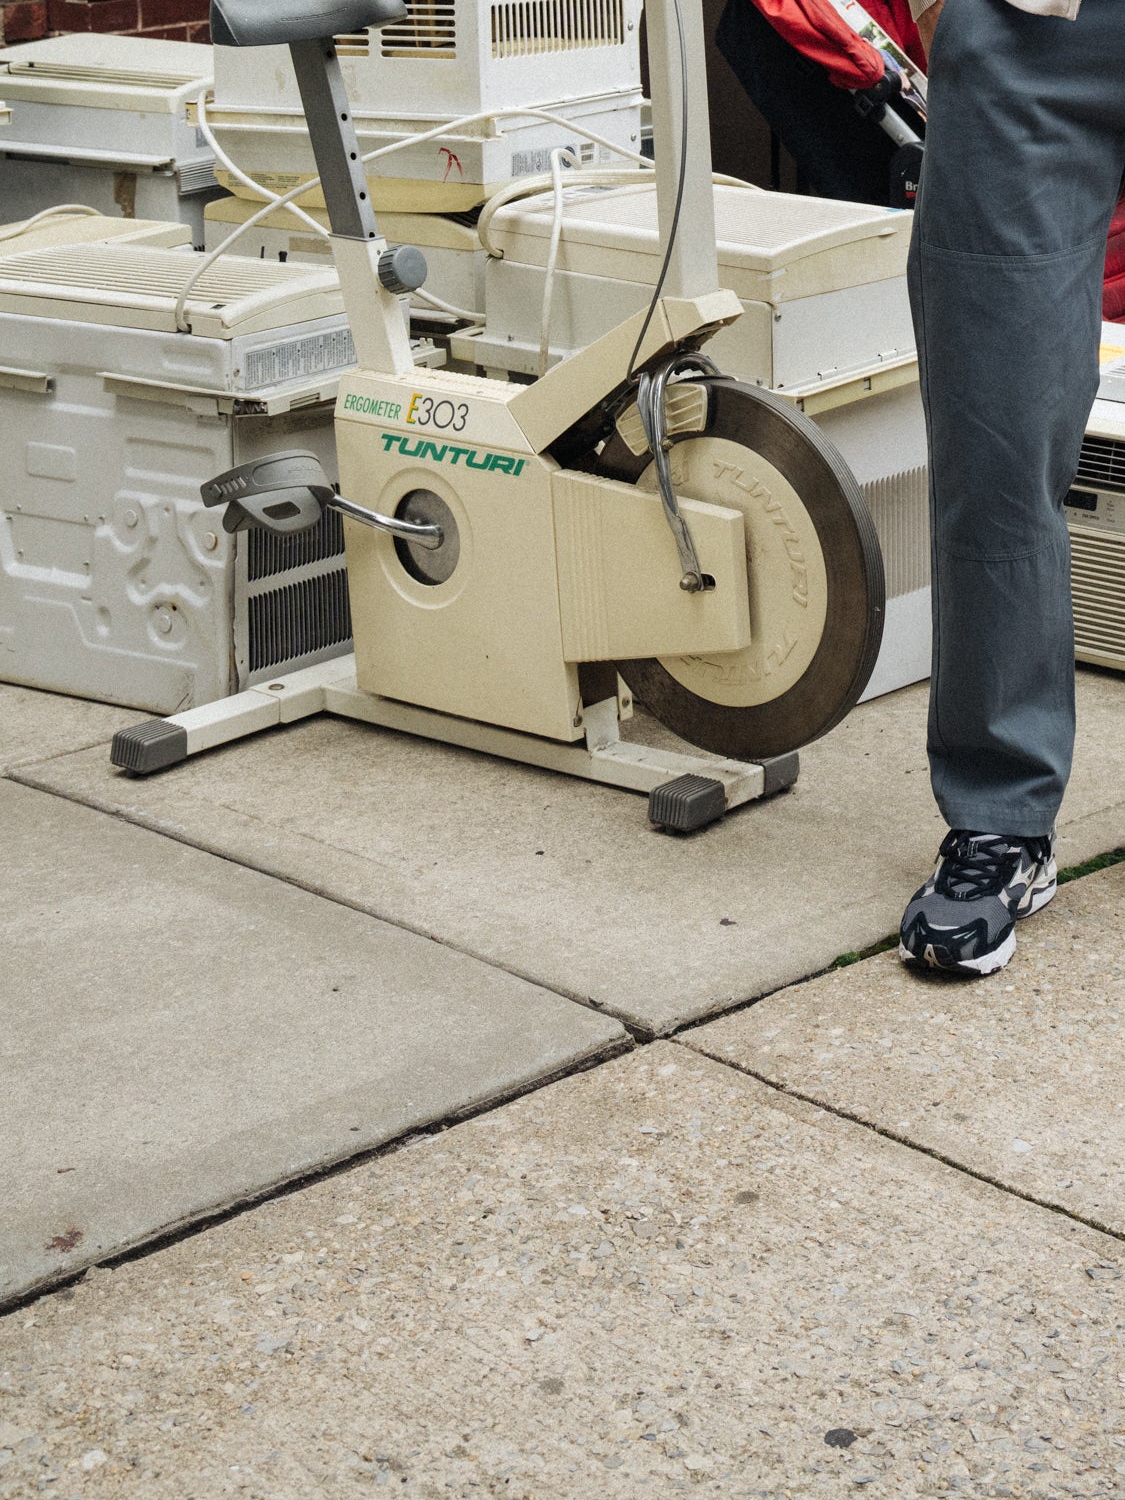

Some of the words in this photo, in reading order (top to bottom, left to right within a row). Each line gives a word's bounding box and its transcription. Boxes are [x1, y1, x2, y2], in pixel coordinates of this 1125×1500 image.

[344, 393, 402, 420] ERGOMETER
[406, 392, 469, 431] E303
[381, 433, 526, 477] TUNTURI
